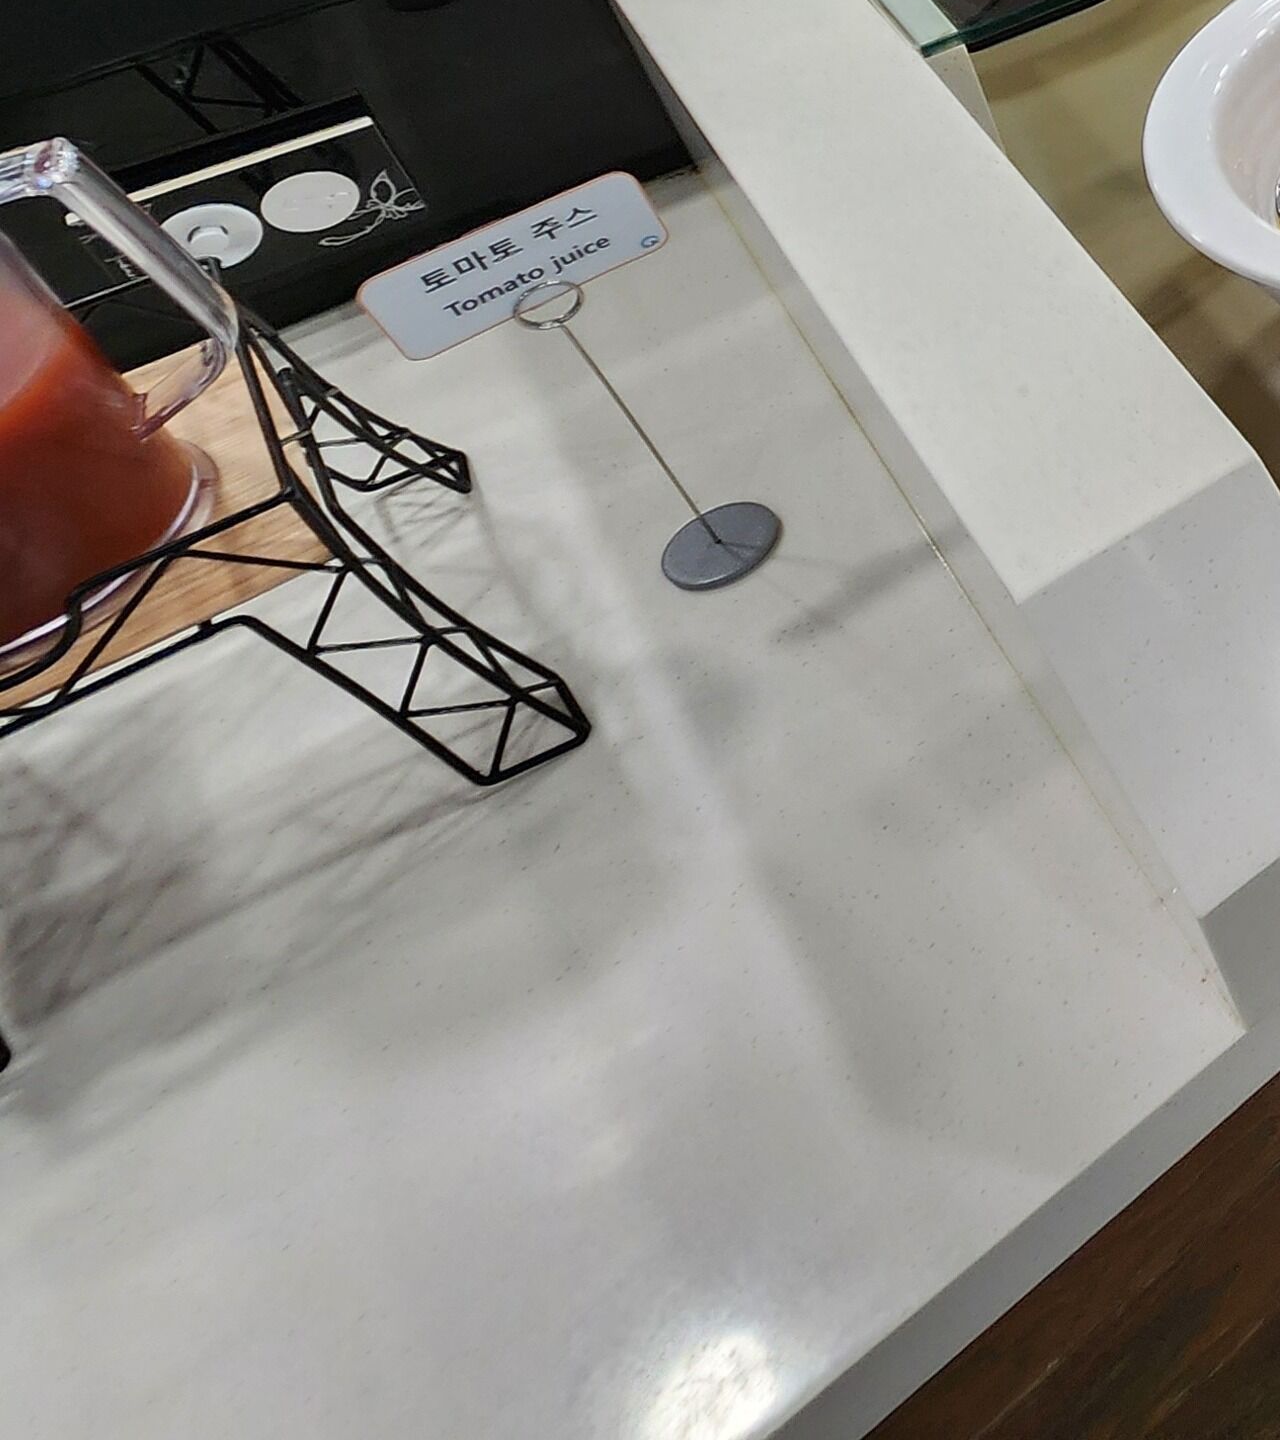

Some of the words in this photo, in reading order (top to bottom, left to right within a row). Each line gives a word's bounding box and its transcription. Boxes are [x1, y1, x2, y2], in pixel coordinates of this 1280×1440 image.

[420, 237, 524, 294] 토마토
[531, 205, 600, 242] 주스
[443, 266, 545, 317] Tomato
[552, 235, 612, 276] juice
